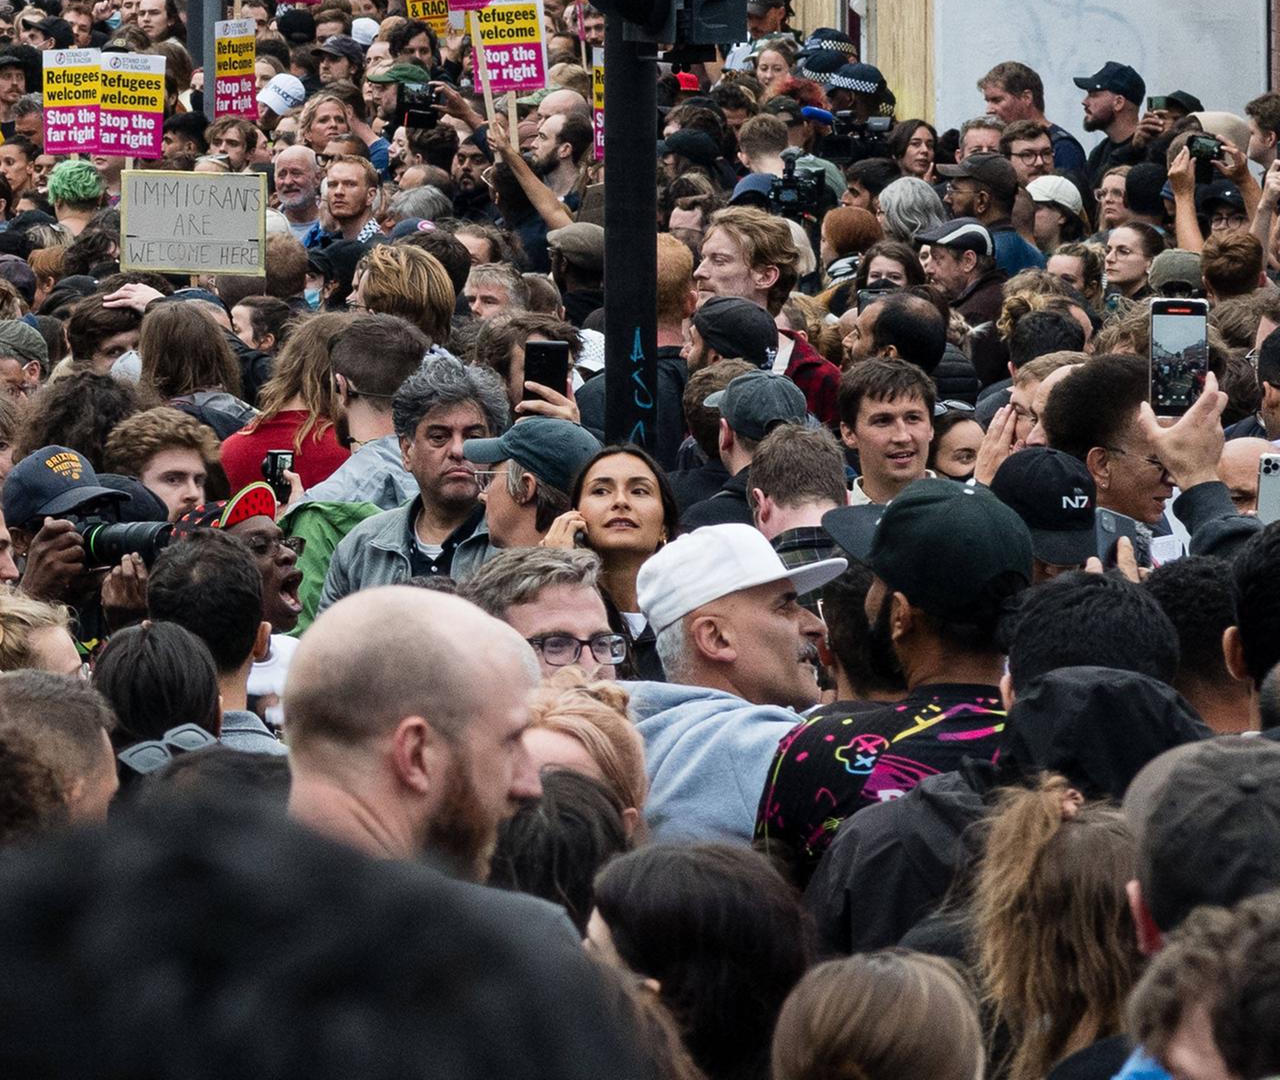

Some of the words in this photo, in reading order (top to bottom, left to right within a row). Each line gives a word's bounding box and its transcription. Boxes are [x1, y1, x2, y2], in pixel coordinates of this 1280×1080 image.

[47, 69, 100, 88] Refugees
[47, 87, 97, 101] welcome
[47, 110, 76, 126] Stop
[78, 110, 96, 124] the
[47, 127, 65, 141] far
[68, 127, 95, 144] right
[133, 181, 262, 212] IMMIGRANTS
[173, 215, 214, 237] ARE
[130, 243, 209, 265] WELCOME
[220, 245, 259, 266] HERE
[1062, 495, 1089, 509] N7
